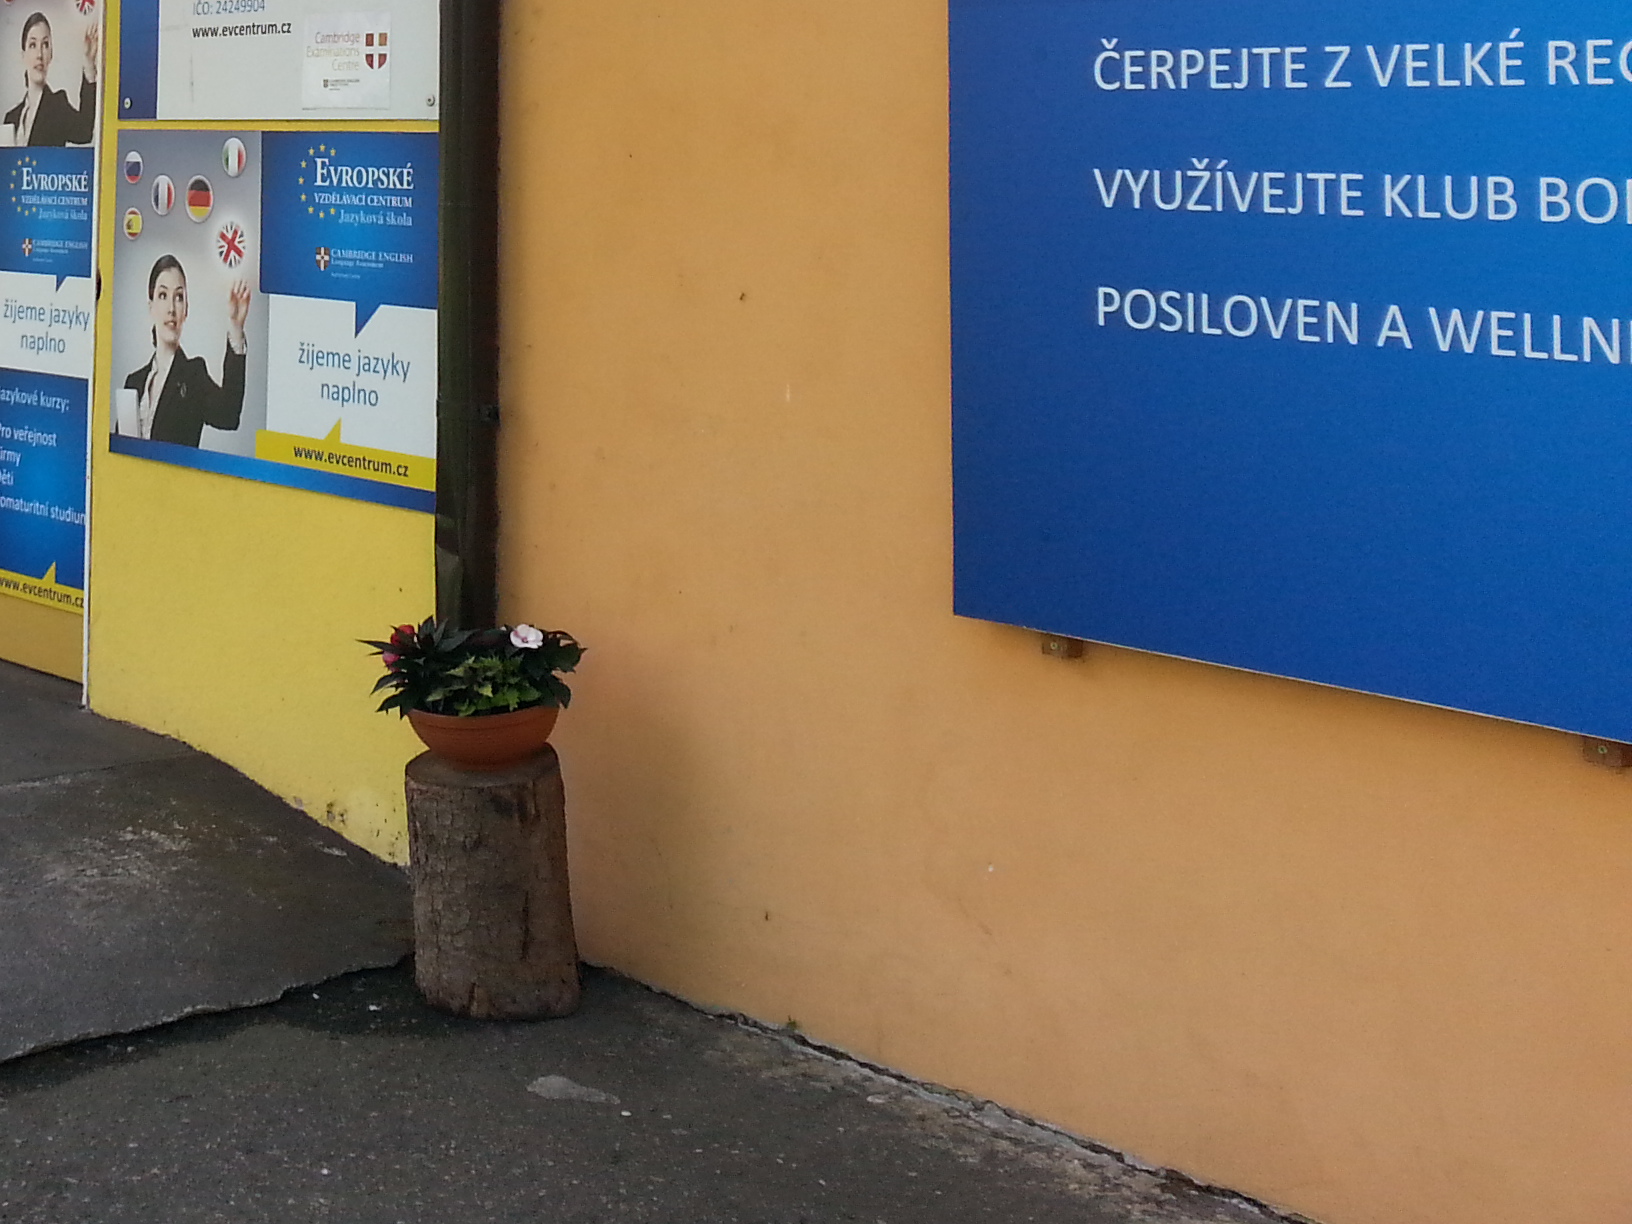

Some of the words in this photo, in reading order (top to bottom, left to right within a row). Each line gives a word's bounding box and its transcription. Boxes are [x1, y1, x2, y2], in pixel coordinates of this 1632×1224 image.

[192, 21, 292, 38] www.evcentrum.cz
[315, 31, 360, 46] Cambridge
[1093, 38, 1308, 90] ČERPEJTE
[1324, 45, 1352, 89] Z
[1366, 28, 1526, 88] VELKÉ
[314, 192, 366, 206] VZDĚLÁVACÍ
[368, 195, 412, 208] CENTRUM
[1093, 157, 1365, 217] VYUŽÍVEJTE
[1384, 173, 1519, 222] KLUB
[1540, 177, 1632, 225] BO
[338, 209, 384, 226] Jazyková
[386, 212, 413, 227] škola
[331, 248, 376, 260] CAMBRIDGE
[378, 251, 413, 263] ENGLISH
[3, 299, 45, 324] žijeme
[48, 303, 90, 332] jazyky
[1096, 286, 1360, 346] POSILOVEN
[1377, 304, 1413, 349] A
[20, 331, 66, 355] naplno
[298, 342, 351, 371] žijeme
[356, 349, 410, 383] jazyky
[40, 391, 70, 414] kurzy:
[321, 380, 379, 408] naplno
[13, 426, 57, 447] veřejnost
[293, 446, 409, 477] www.evcentrum.cz
